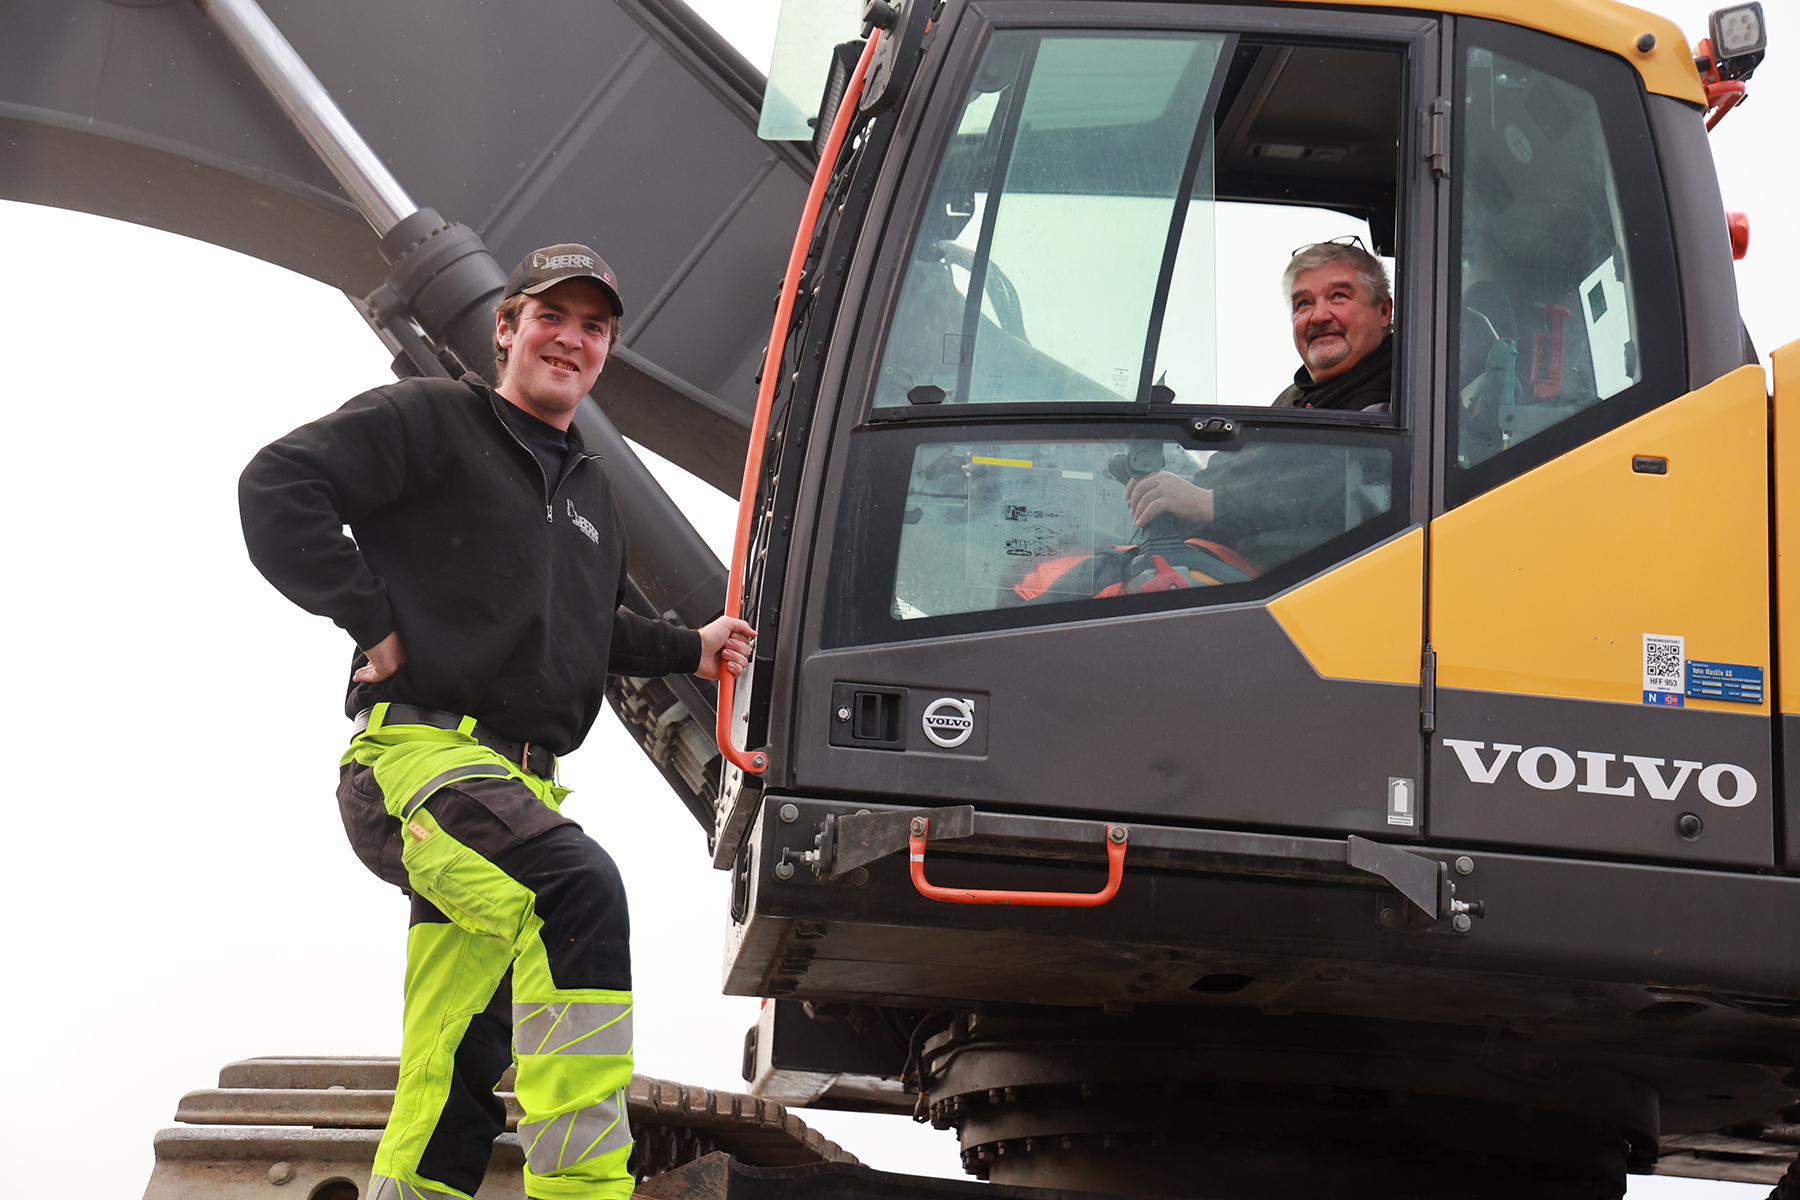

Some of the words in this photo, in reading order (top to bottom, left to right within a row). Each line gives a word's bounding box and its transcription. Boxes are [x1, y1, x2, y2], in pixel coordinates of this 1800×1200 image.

[553, 254, 594, 270] BERRE
[1725, 669, 1733, 678] AS
[1649, 677, 1664, 686] HFF
[1664, 678, 1678, 687] 953
[1648, 692, 1657, 703] N
[925, 717, 972, 728] VOLVO
[1443, 738, 1758, 808] VOLVO
